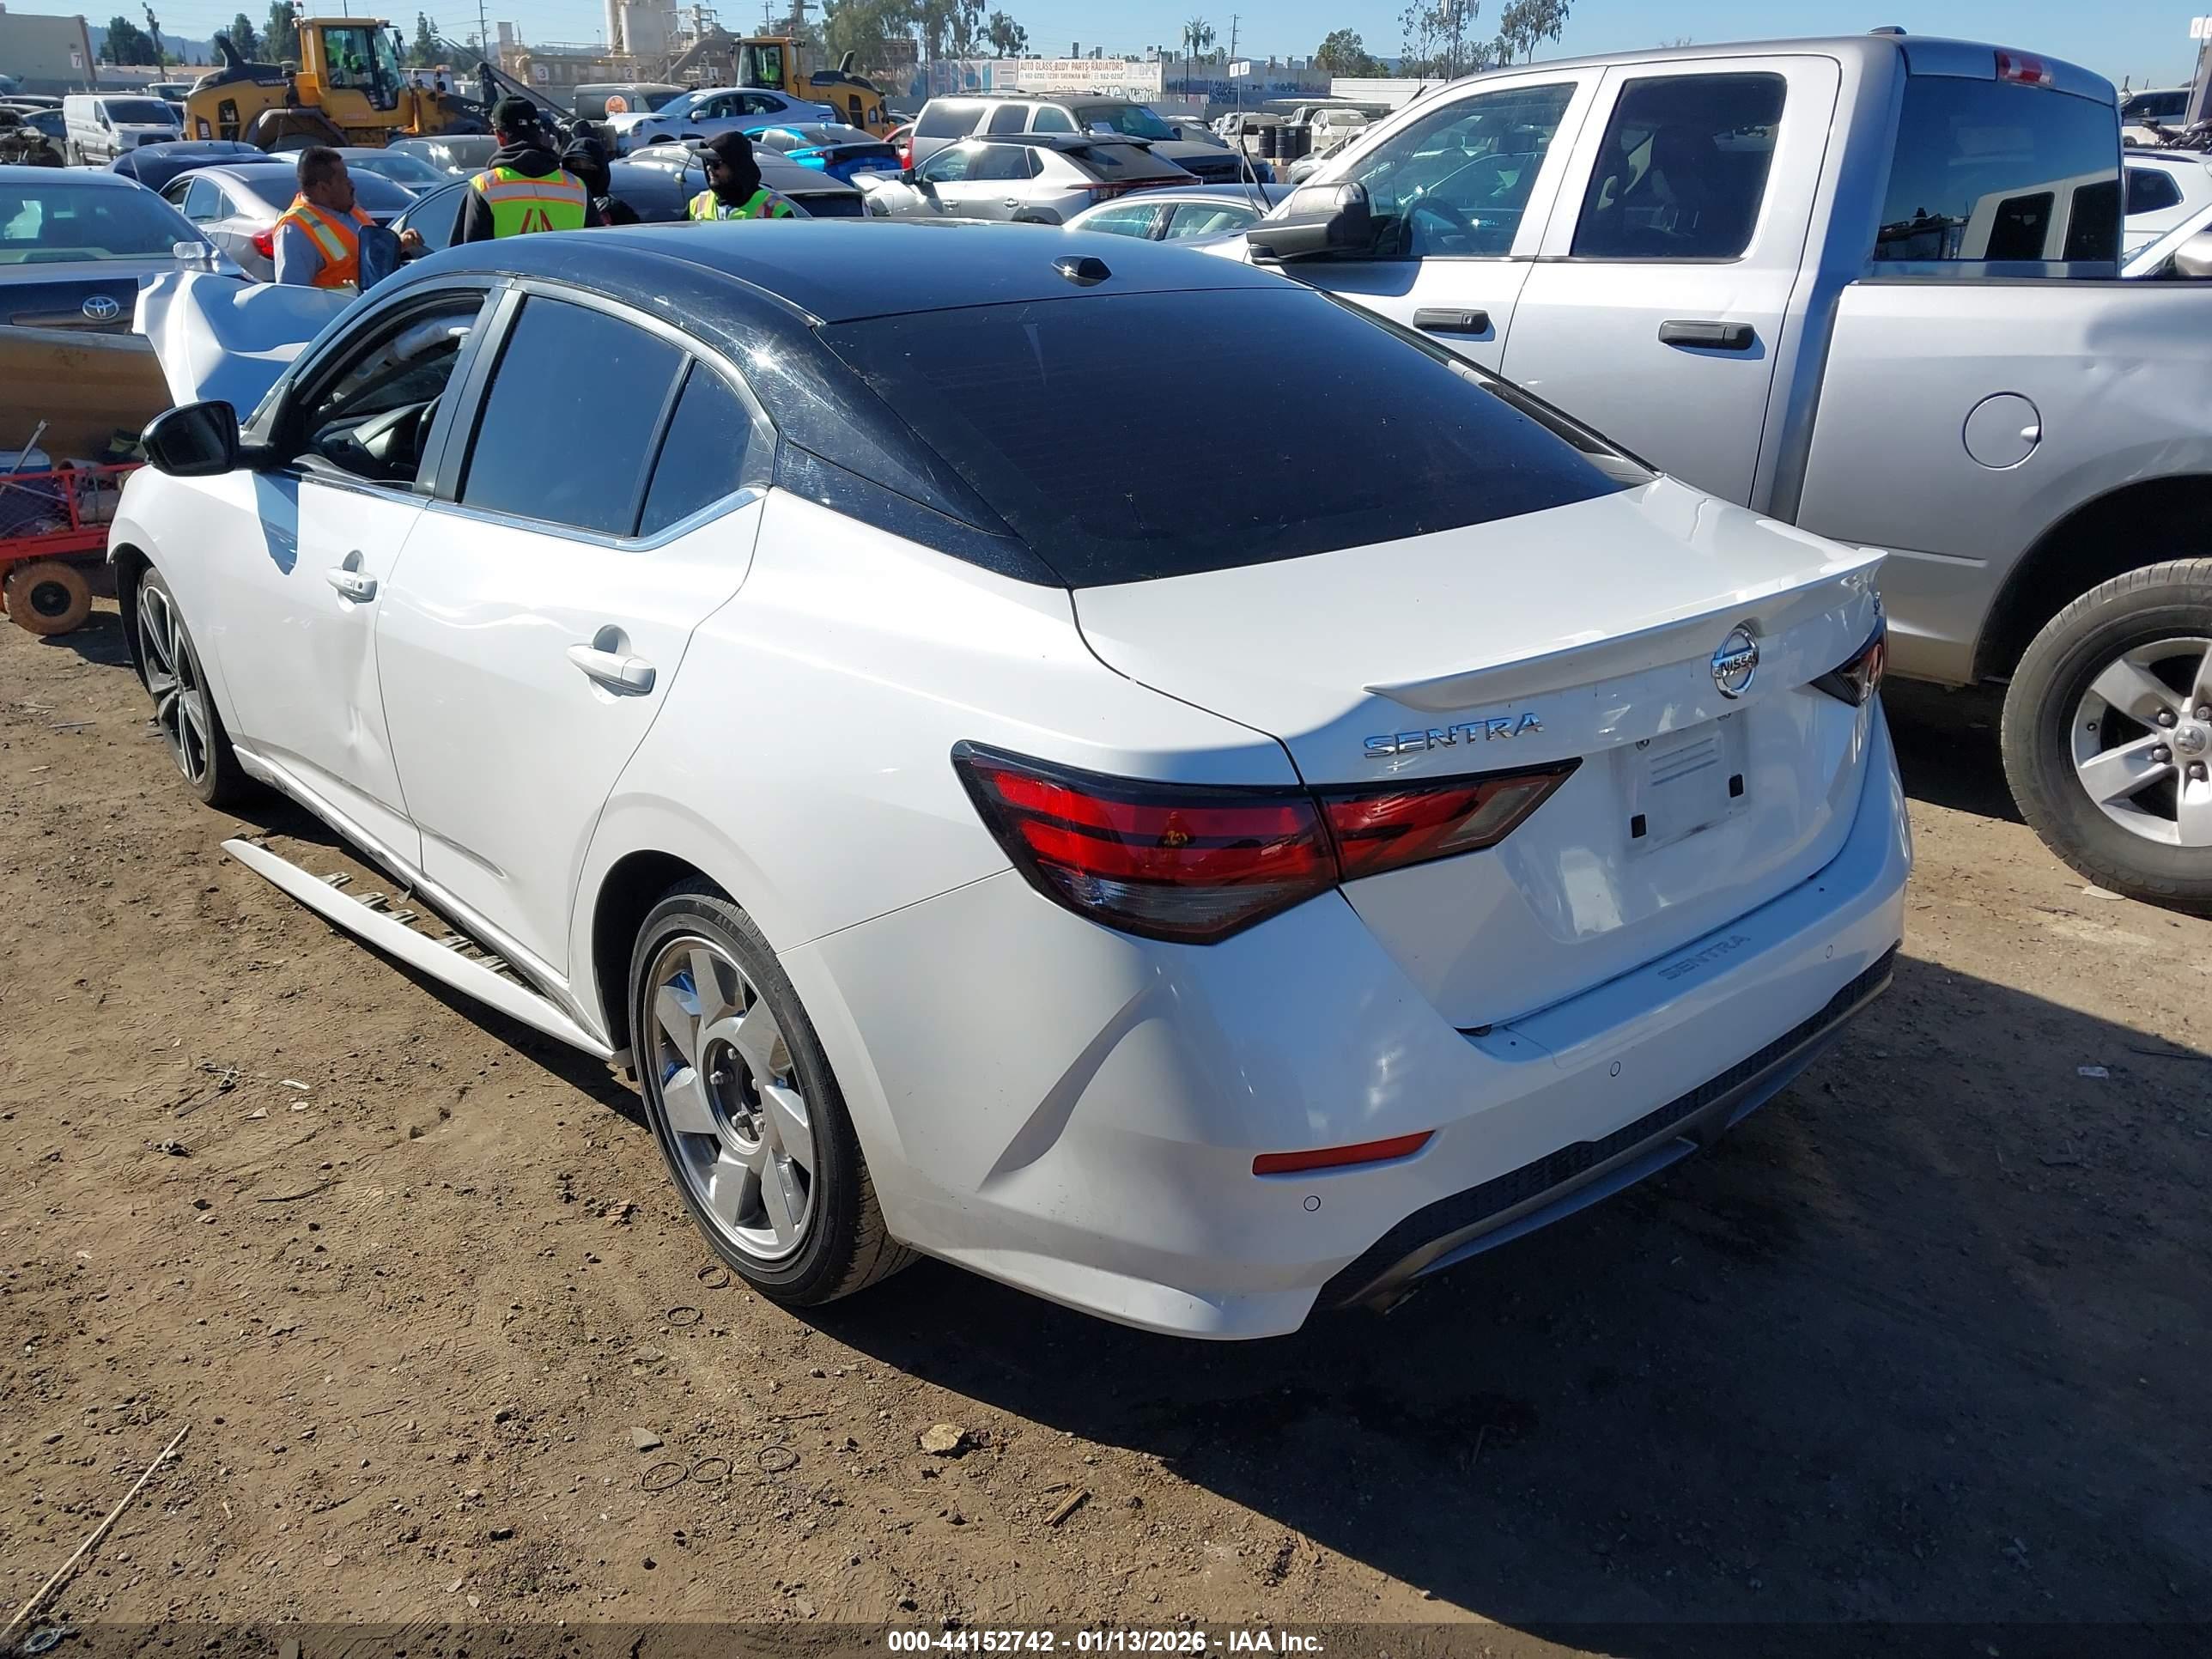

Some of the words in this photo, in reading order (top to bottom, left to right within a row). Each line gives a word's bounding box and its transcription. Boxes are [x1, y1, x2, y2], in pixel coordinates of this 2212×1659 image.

[73, 55, 82, 66] 7
[1020, 62, 1034, 70] AUTO
[1091, 62, 1124, 71] RADIATORS
[539, 68, 546, 78] 3
[626, 69, 633, 78] 2
[1364, 713, 1544, 758] SENTRA
[1657, 934, 1751, 980] SENTRA
